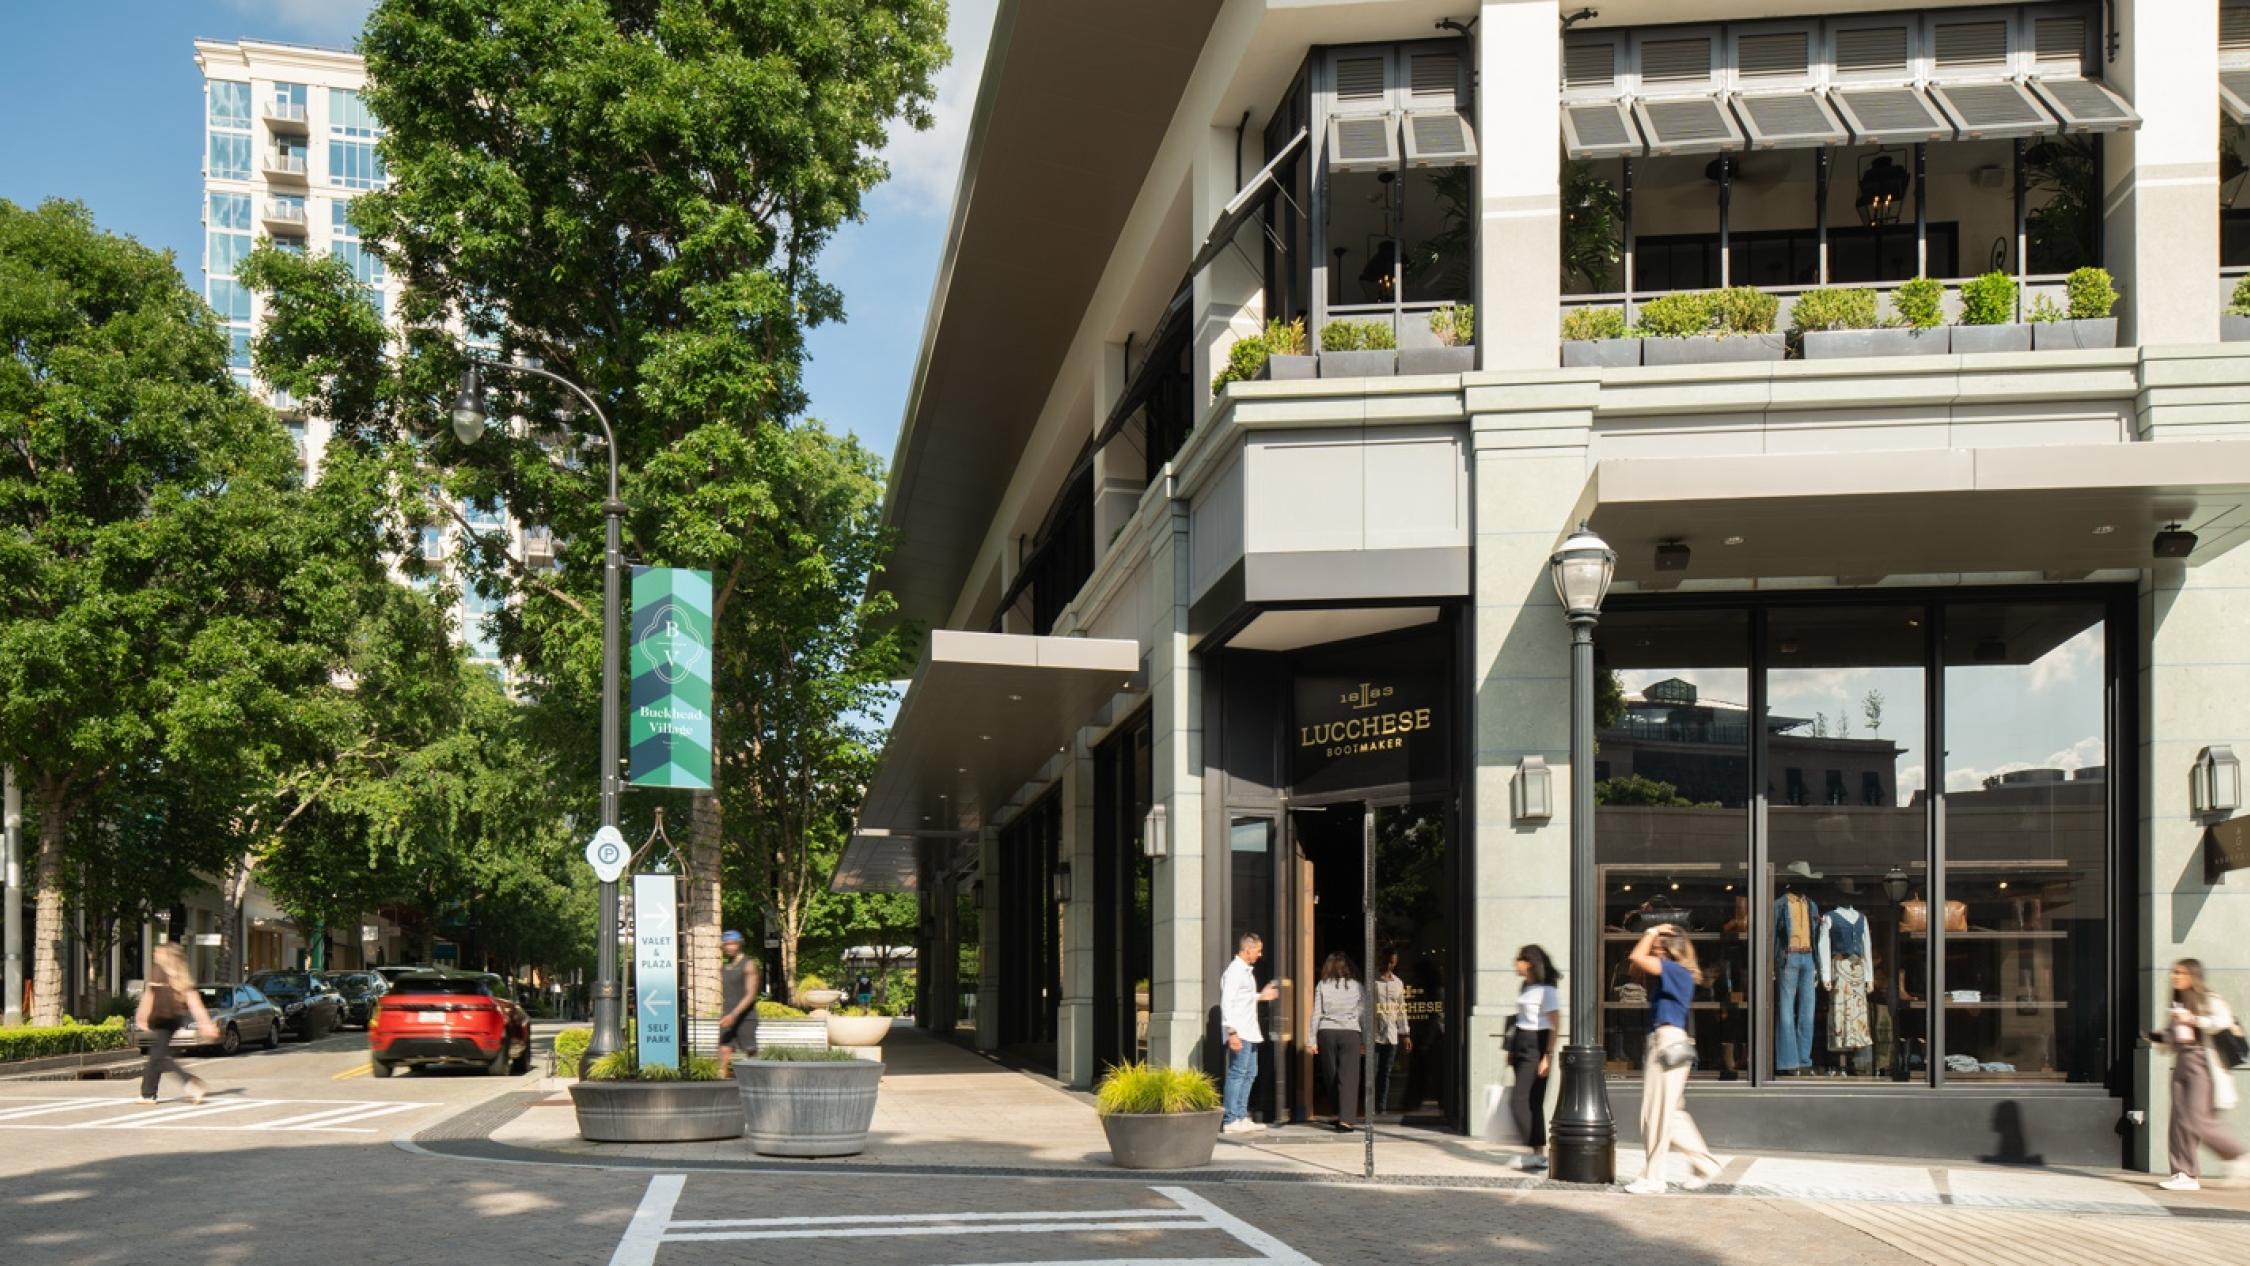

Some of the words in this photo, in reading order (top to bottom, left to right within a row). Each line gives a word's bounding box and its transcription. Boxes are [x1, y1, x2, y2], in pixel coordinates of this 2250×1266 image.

[665, 620, 679, 638] B
[663, 650, 681, 667] V
[640, 705, 704, 721] Buckhead
[649, 721, 694, 737] Village
[1301, 708, 1431, 746] LUCCHESE
[1326, 737, 1403, 758] BOOTMAKER
[604, 847, 615, 860] P
[641, 936, 672, 946] VALET
[653, 948, 660, 957] &
[641, 959, 673, 969] PLAZA
[1376, 1001, 1443, 1014] LUCCHESE
[647, 1023, 669, 1033] SELF
[646, 1034, 671, 1044] PARK
